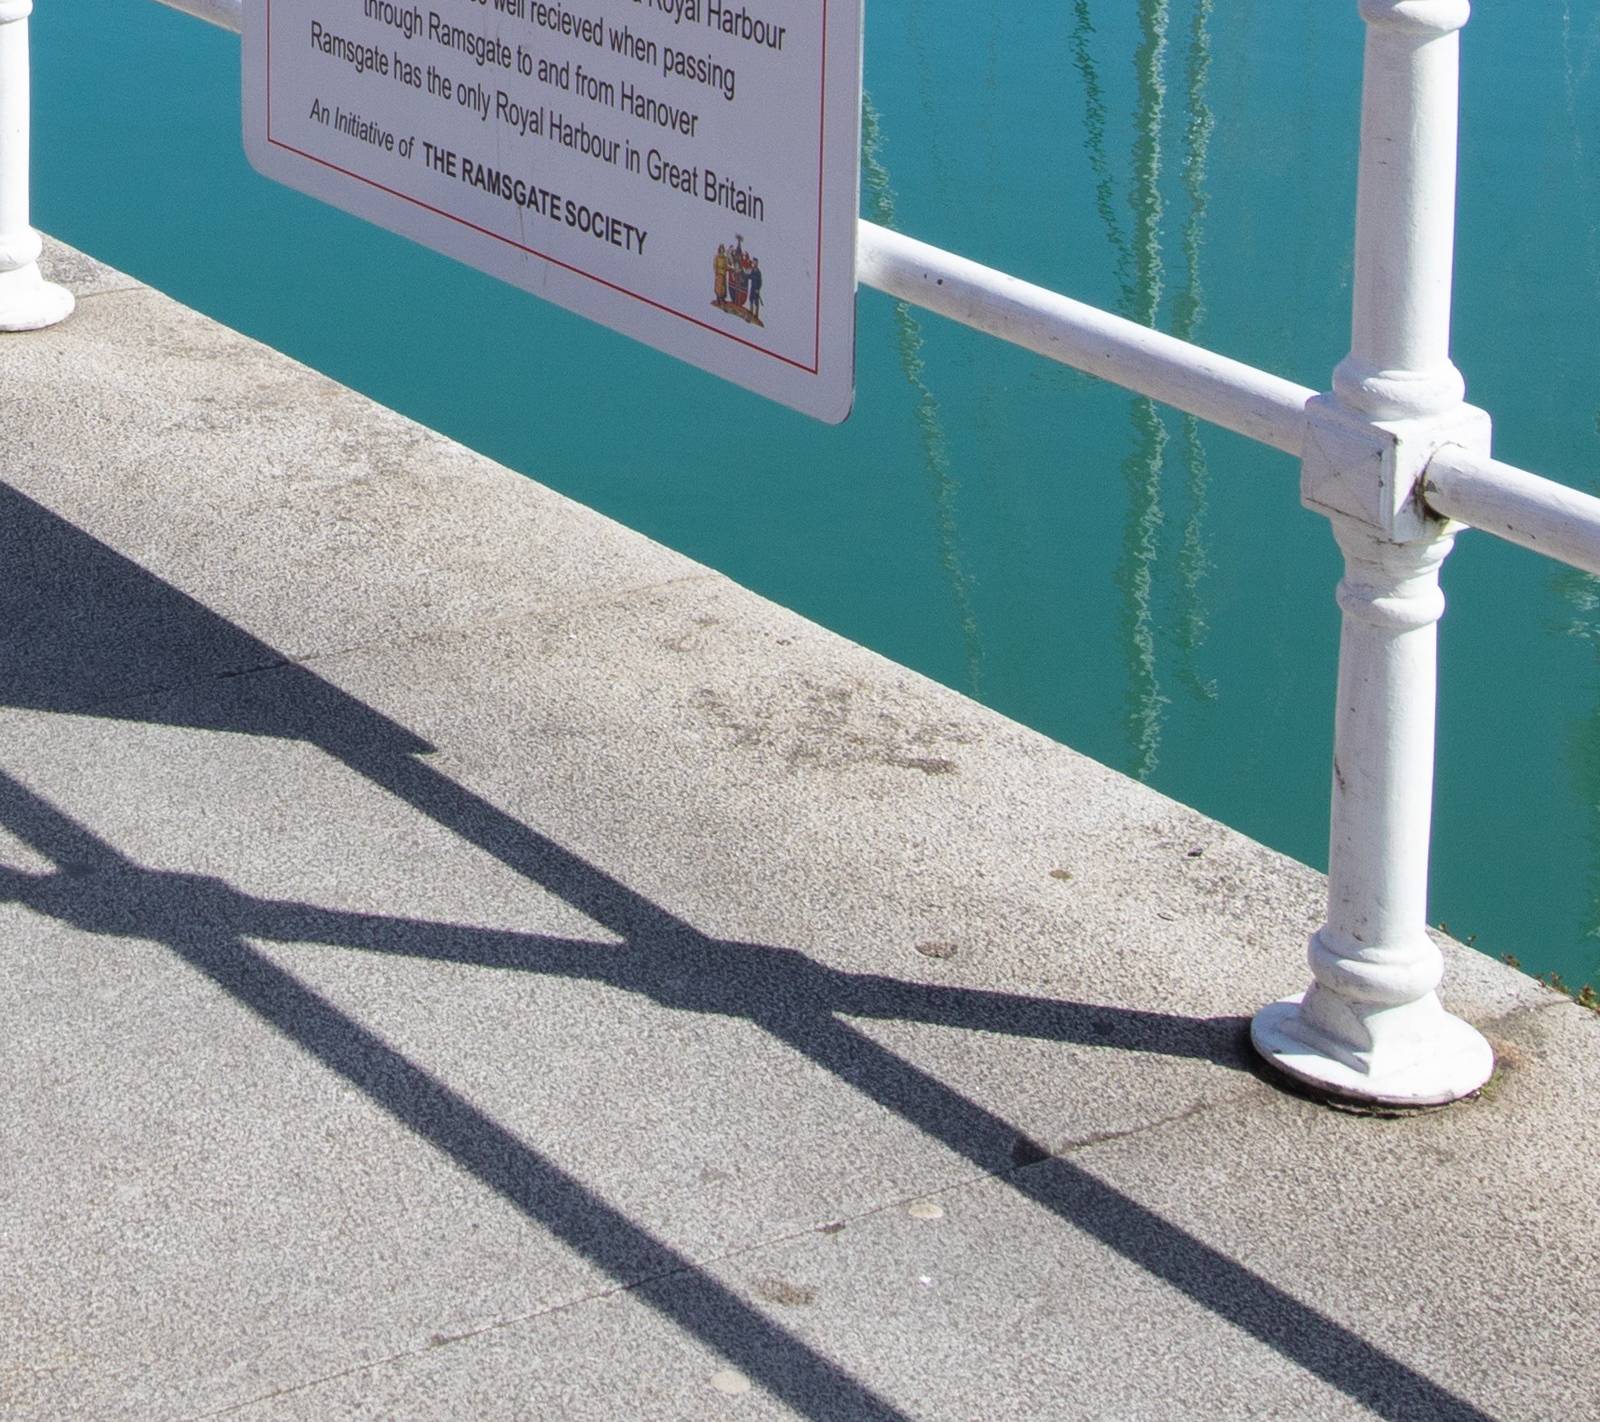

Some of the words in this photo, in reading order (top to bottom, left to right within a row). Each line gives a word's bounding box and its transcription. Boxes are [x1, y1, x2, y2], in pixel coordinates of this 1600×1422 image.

[311, 20, 389, 76] Ramsgate
[394, 51, 422, 88] has
[427, 65, 451, 100] the
[457, 83, 490, 121] only
[496, 90, 544, 137] Royal
[550, 110, 620, 165] Harbour
[626, 140, 640, 174] in
[647, 149, 698, 196] Great
[704, 169, 764, 222] Britain
[429, 11, 512, 69] Ramsgate
[517, 45, 533, 76] to
[538, 58, 569, 90] and
[575, 65, 614, 107] from
[621, 80, 698, 137] Hanover
[530, 0, 603, 47] recieved
[609, 25, 657, 66] when
[663, 46, 735, 101] passing
[309, 98, 330, 126] An
[334, 107, 394, 152] Initiative
[398, 136, 415, 159] of
[423, 141, 457, 178] THE
[462, 157, 562, 222] RAMSGATE
[565, 200, 648, 256] SOCIETY
